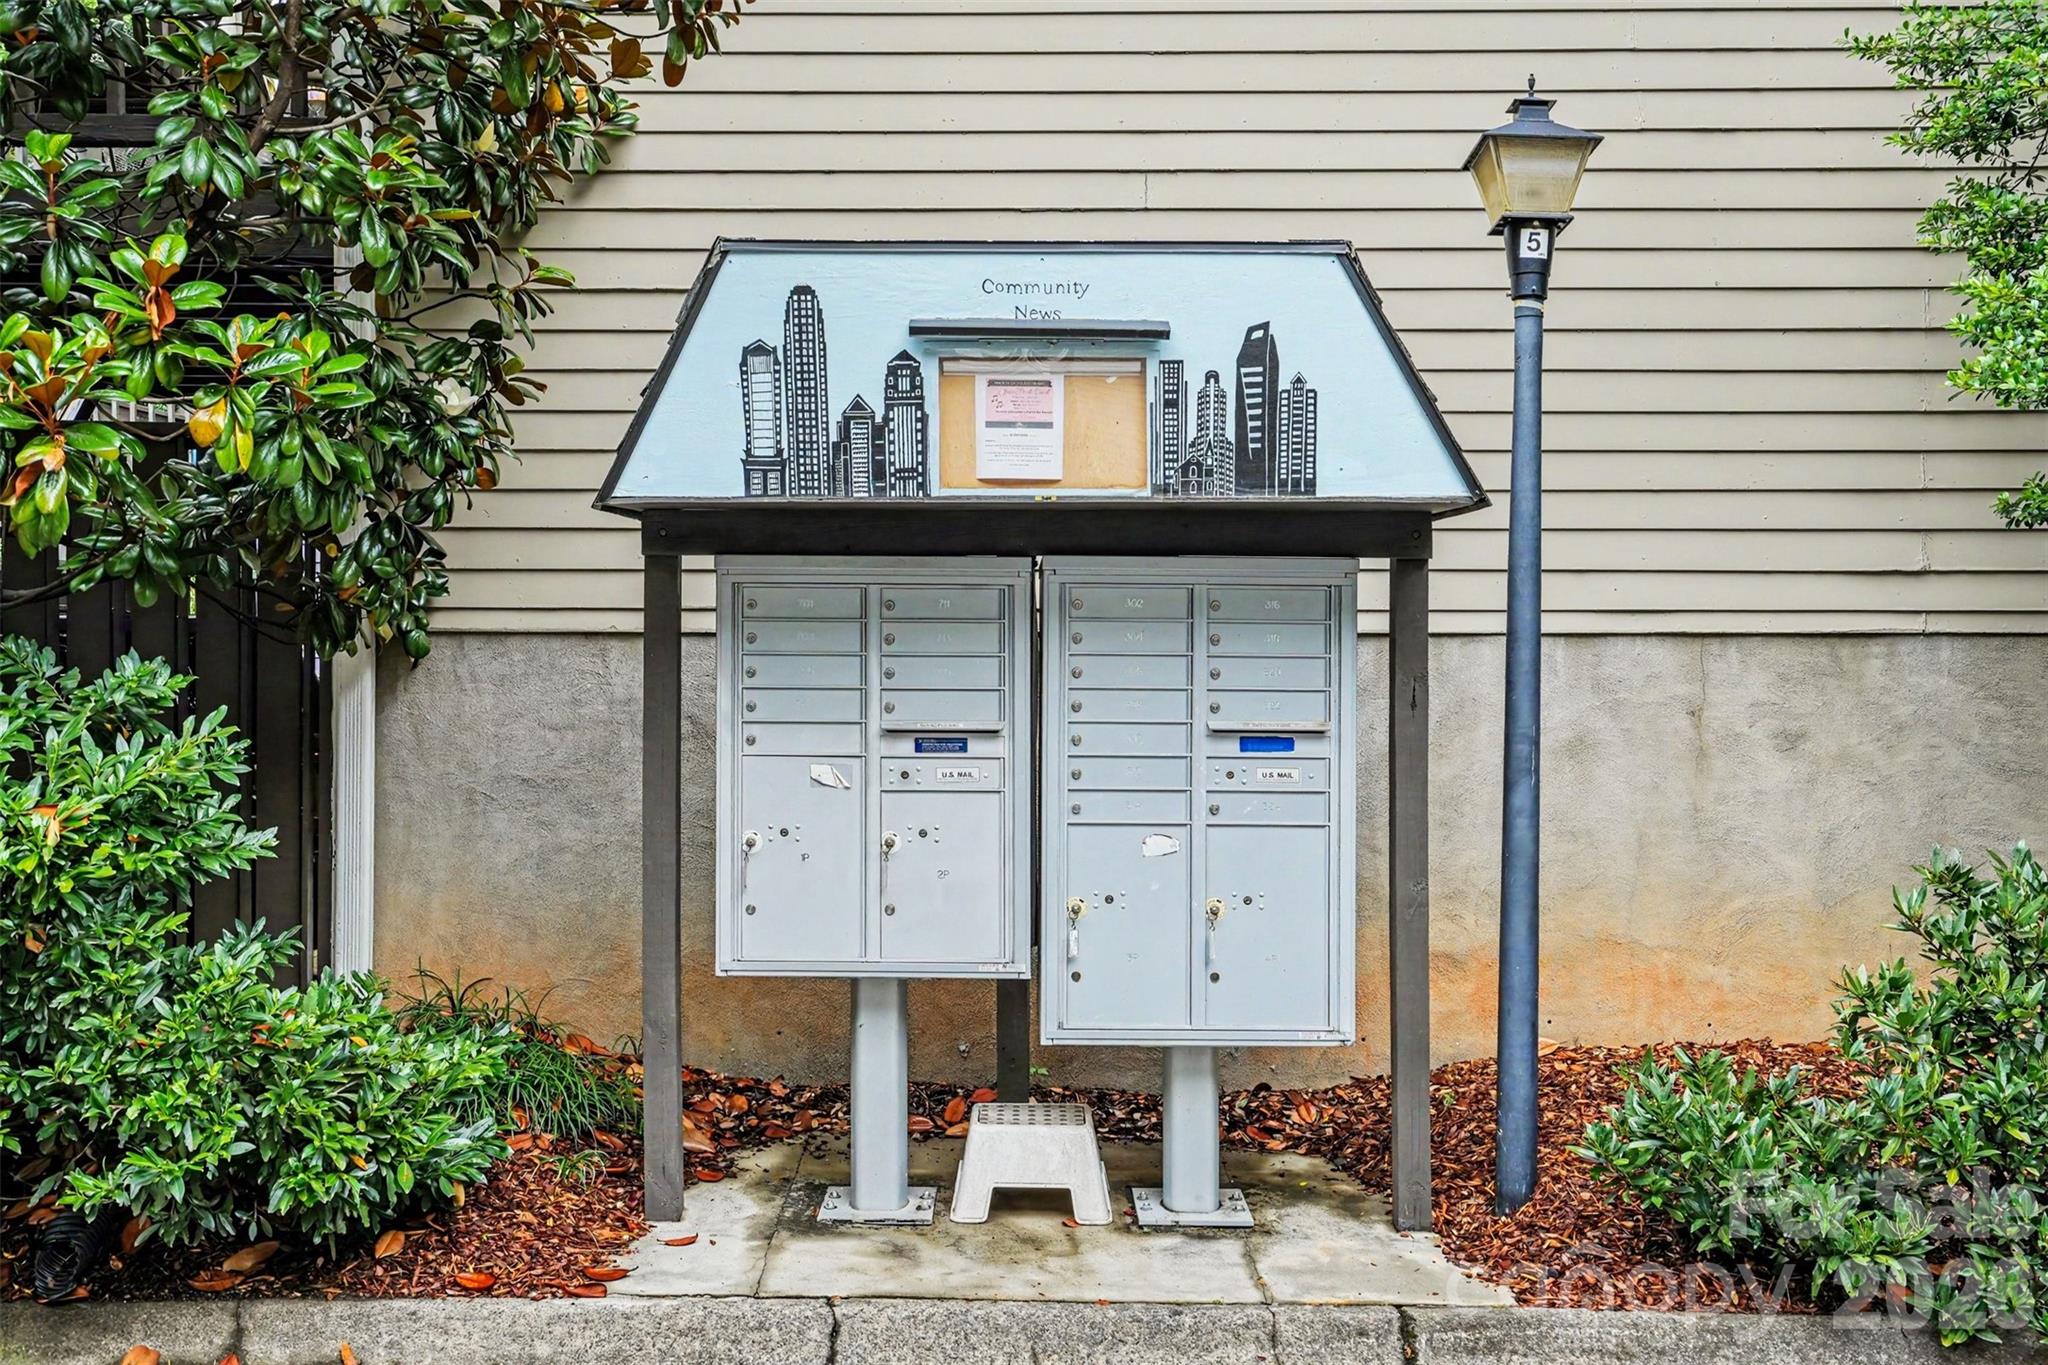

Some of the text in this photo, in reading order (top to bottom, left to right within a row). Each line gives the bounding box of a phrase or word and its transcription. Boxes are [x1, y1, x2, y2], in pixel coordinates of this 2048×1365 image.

[1526, 231, 1541, 252] 5
[981, 278, 1090, 299] Community
[1014, 305, 1062, 320] News
[1277, 771, 1294, 779] MAIL
